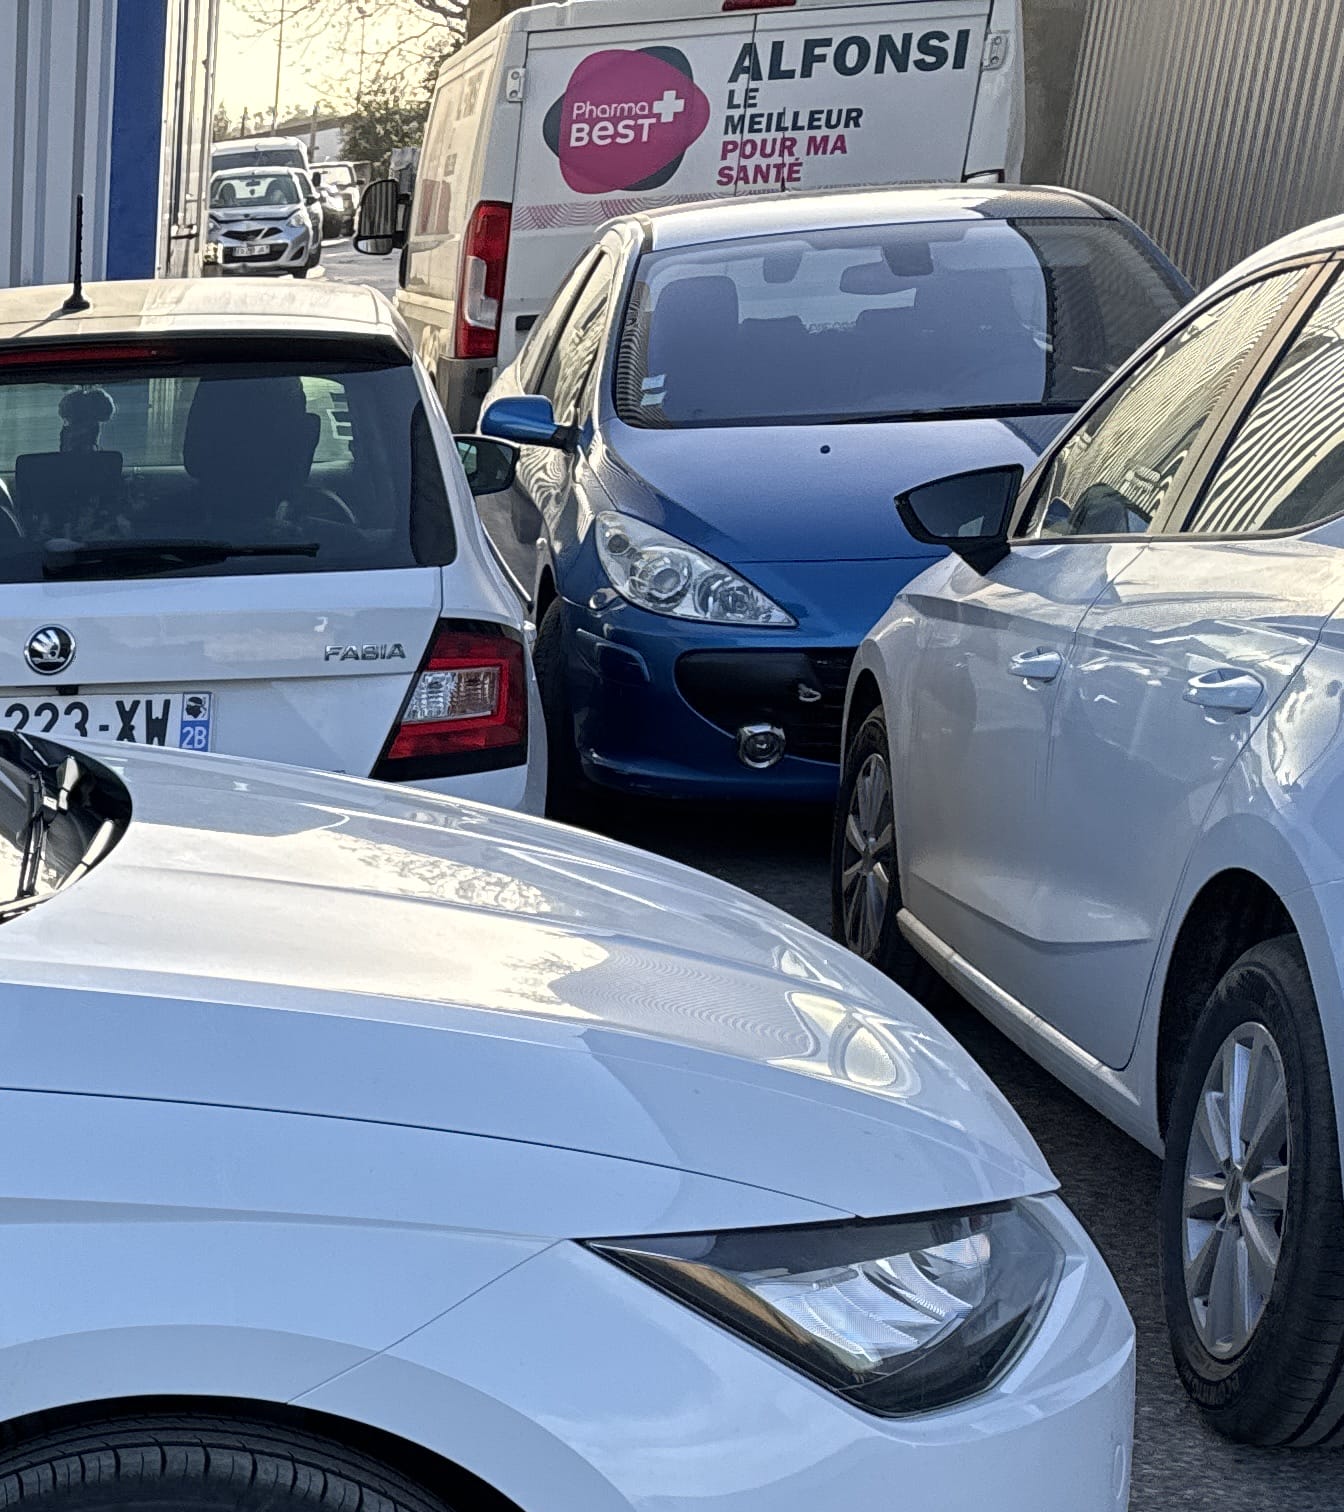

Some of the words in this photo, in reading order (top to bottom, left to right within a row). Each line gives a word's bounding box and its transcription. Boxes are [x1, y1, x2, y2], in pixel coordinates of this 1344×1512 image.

[727, 29, 971, 83] ALFONSI
[572, 101, 650, 120] Pharma
[726, 88, 760, 109] LE
[723, 107, 864, 136] MEILLEUR
[720, 136, 797, 161] POUR
[805, 134, 848, 156] MA
[716, 157, 804, 186] SANTÉ
[324, 643, 407, 661] FABIA
[182, 726, 208, 748] 2B
